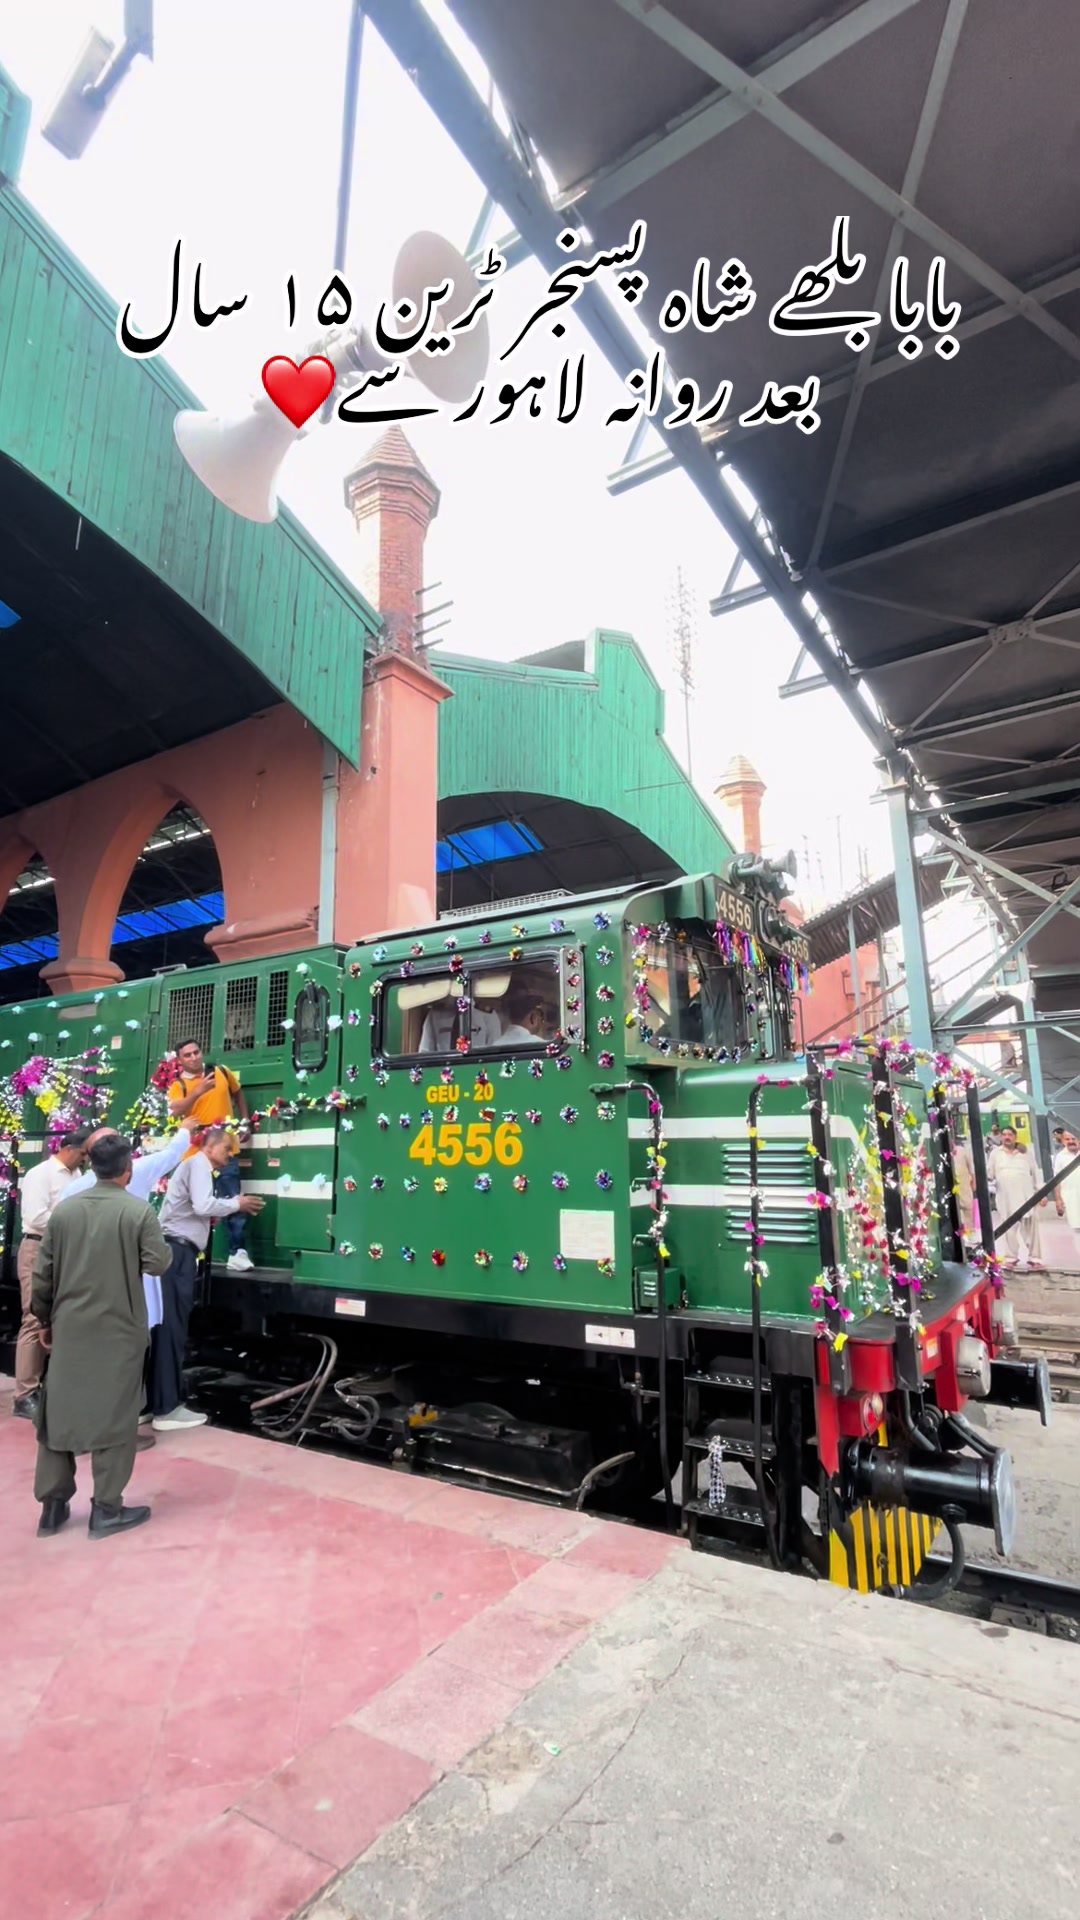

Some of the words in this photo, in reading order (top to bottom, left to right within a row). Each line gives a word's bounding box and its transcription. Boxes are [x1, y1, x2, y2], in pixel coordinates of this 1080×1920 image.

[719, 890, 752, 931] 4556
[426, 1084, 460, 1103] GEU
[473, 1082, 494, 1102] 20
[409, 1122, 523, 1166] 4556
